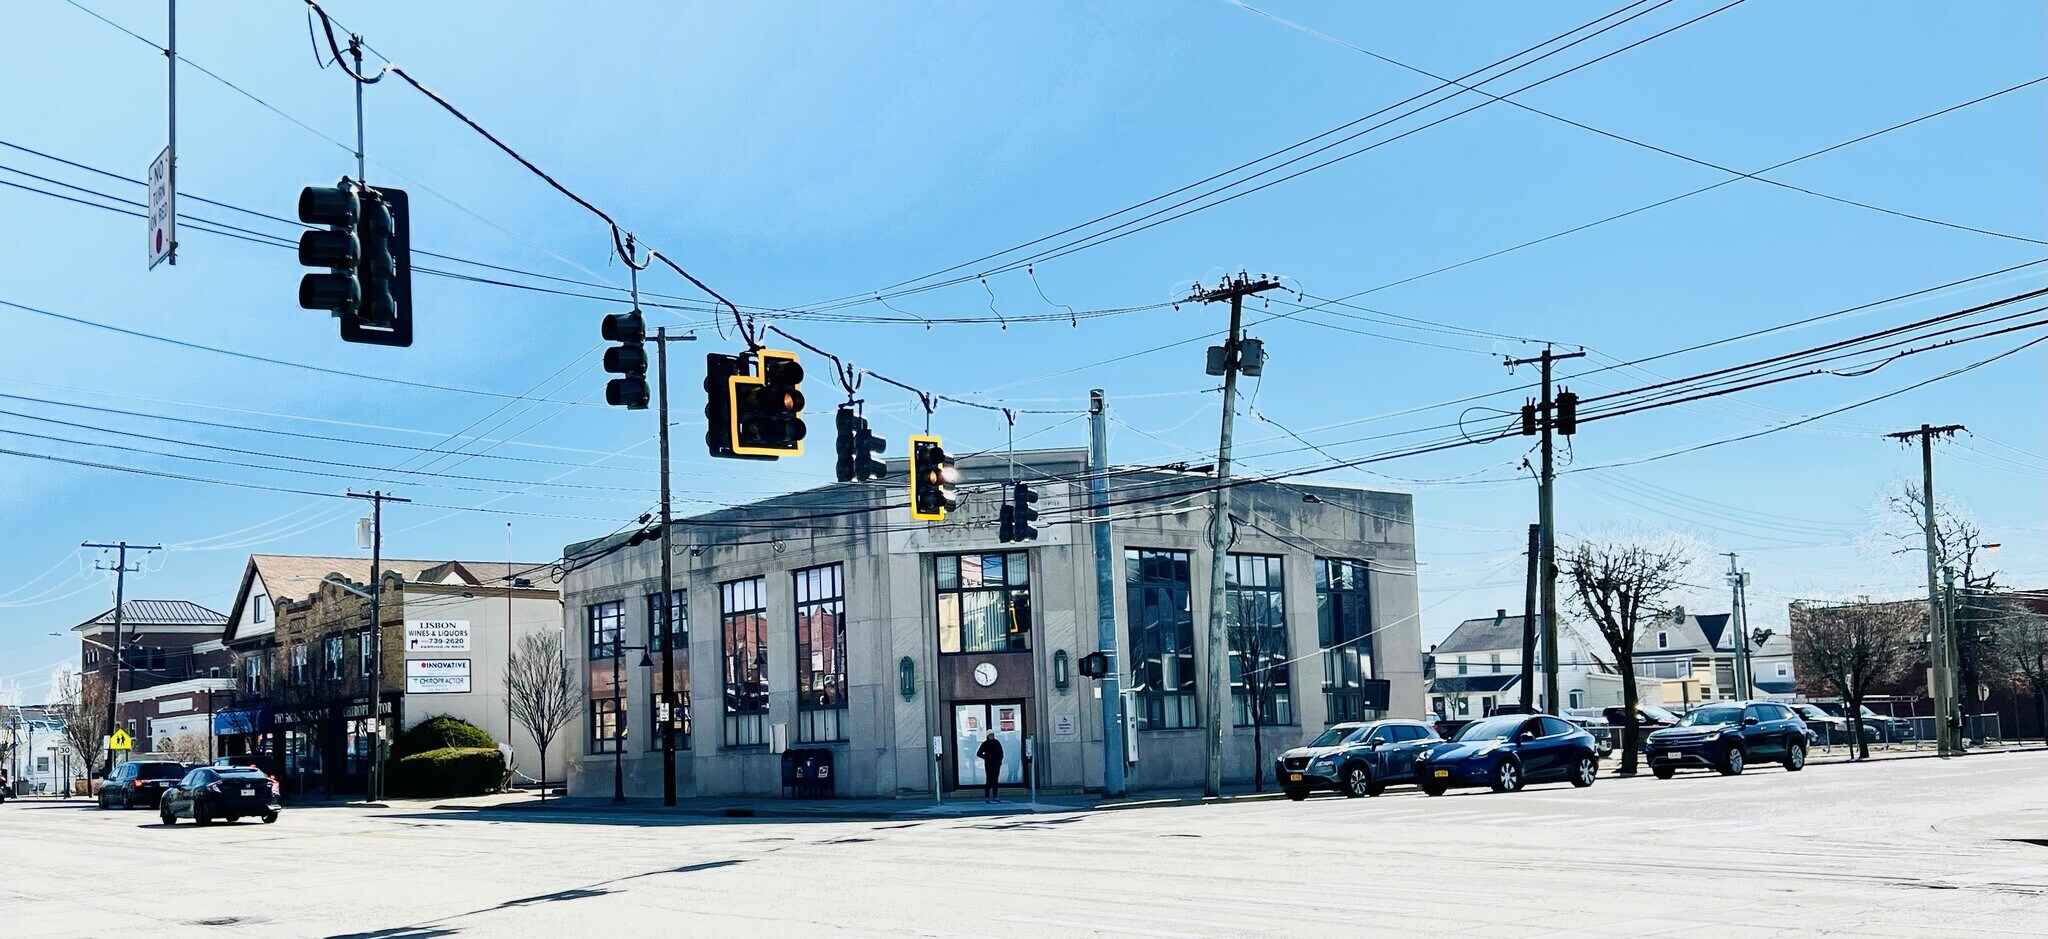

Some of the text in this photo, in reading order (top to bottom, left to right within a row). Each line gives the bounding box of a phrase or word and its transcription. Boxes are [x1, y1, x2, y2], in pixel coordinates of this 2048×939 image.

[154, 160, 164, 186] NO
[153, 183, 165, 208] TURN
[150, 201, 167, 232] ON RED
